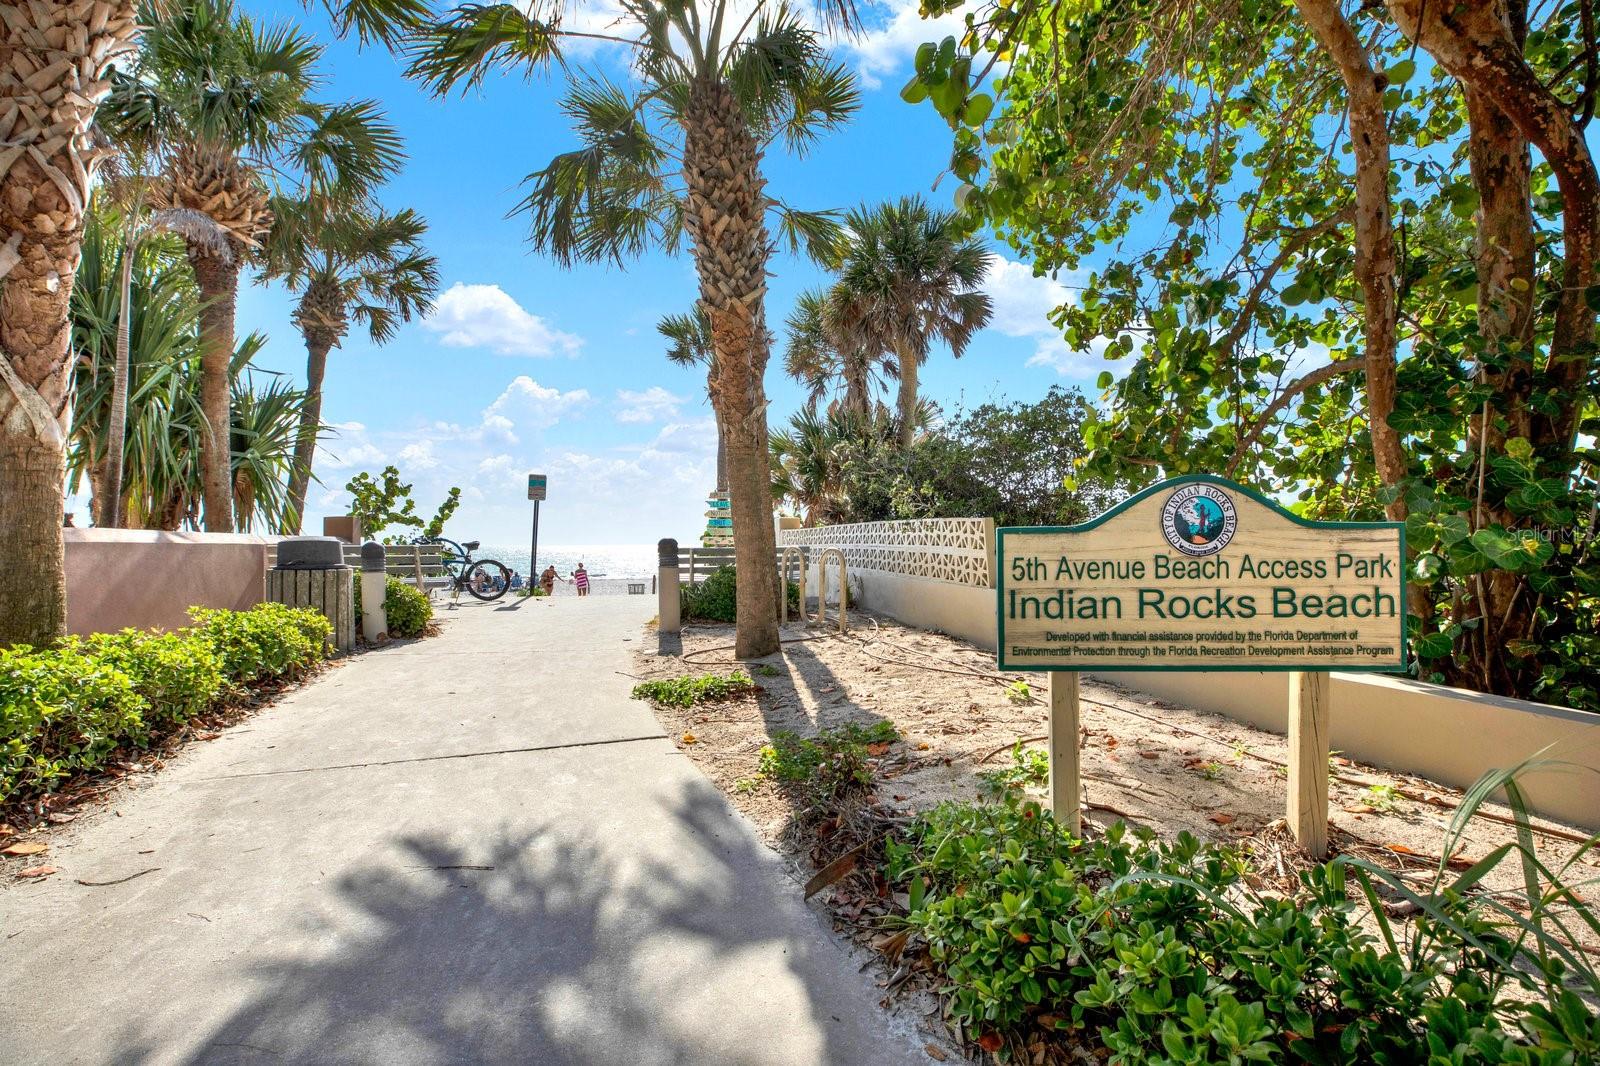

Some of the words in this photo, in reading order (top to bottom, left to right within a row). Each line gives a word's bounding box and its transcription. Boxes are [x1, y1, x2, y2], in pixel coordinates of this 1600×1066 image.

[1168, 486, 1200, 509] INDIAN
[1204, 487, 1232, 512] ROCKS
[1164, 509, 1174, 522] OF
[1165, 524, 1182, 545] CITY
[1216, 515, 1235, 547] BEACH
[1012, 556, 1048, 581] 5th
[1055, 555, 1146, 580] Avenue
[1154, 554, 1230, 579] Beach
[1238, 554, 1327, 579] Access
[1336, 553, 1394, 578] Park
[1010, 589, 1122, 619] Indian
[1138, 588, 1257, 619] Rocks
[1272, 585, 1396, 618] Beach
[1046, 631, 1091, 643] Developed
[1093, 631, 1110, 641] with
[1111, 631, 1147, 641] financial
[1148, 631, 1194, 641] assistance
[1196, 631, 1233, 643] provided
[1236, 631, 1246, 643] by
[1248, 631, 1262, 641] the
[1264, 631, 1294, 641] Florida
[1296, 631, 1347, 643] Department
[1349, 630, 1358, 641] of
[1012, 646, 1071, 656] Environmental
[1073, 646, 1116, 656] Protection
[1118, 646, 1151, 658] through
[1153, 646, 1166, 656] the
[1168, 646, 1198, 656] Florida
[1201, 645, 1246, 656] Recreation
[1248, 645, 1305, 657] Development
[1307, 645, 1354, 656] Assistance
[1356, 645, 1394, 657] Program
